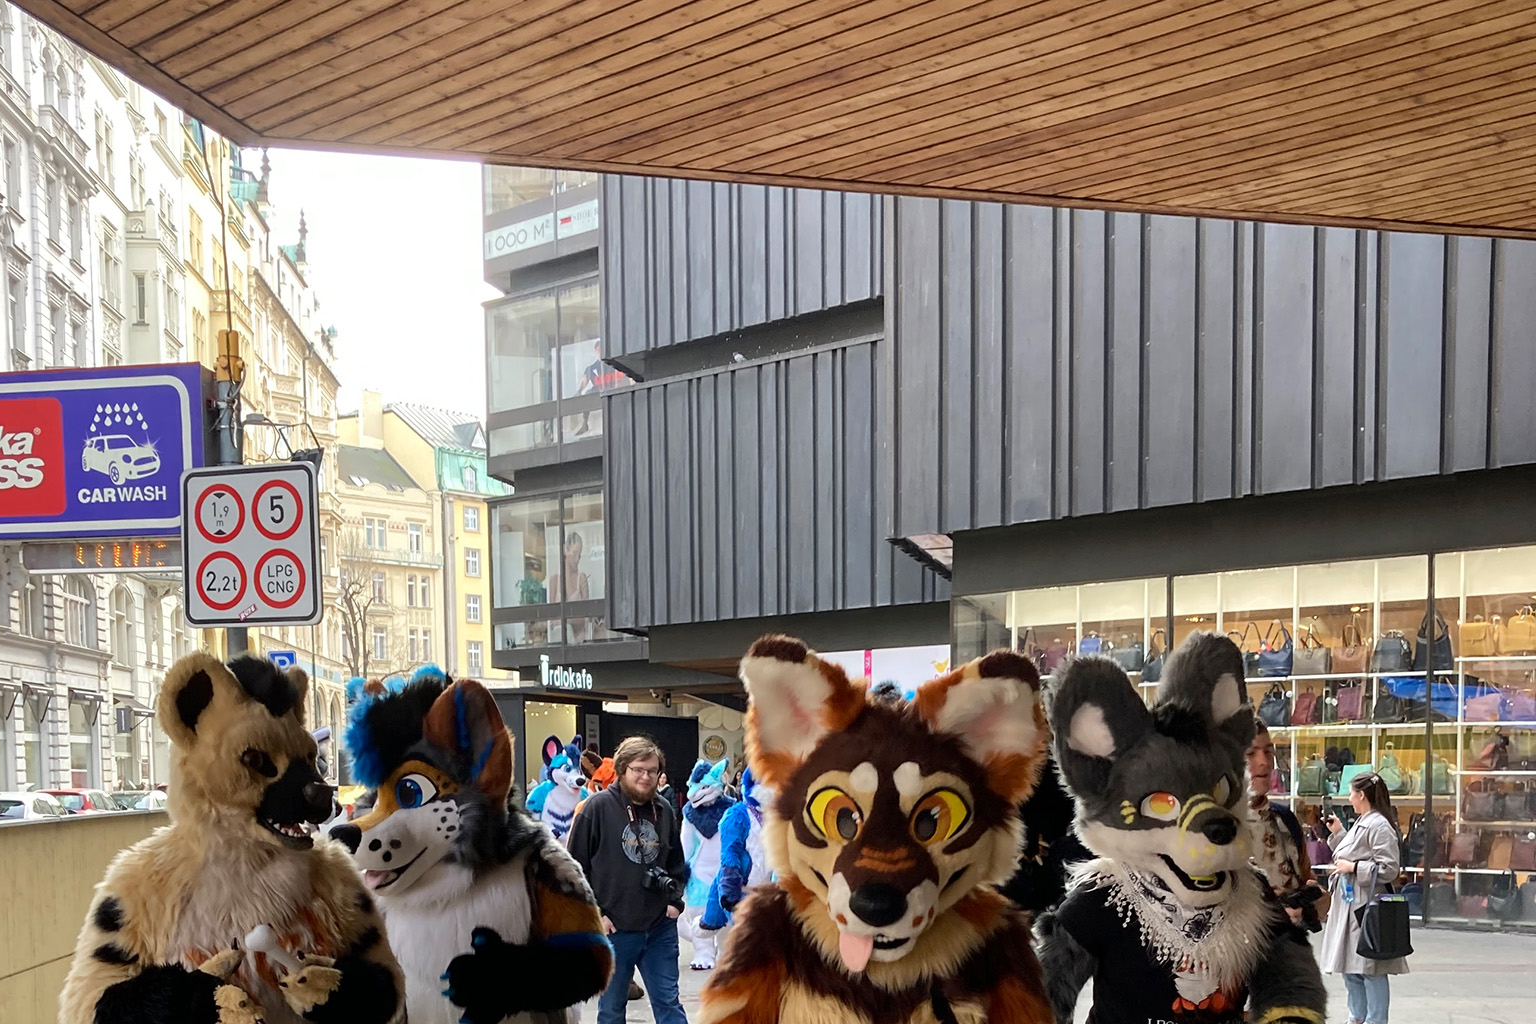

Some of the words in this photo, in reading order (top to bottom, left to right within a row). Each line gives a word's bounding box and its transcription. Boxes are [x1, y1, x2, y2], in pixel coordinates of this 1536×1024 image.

[212, 502, 230, 518] 1,9
[270, 495, 285, 524] 5
[267, 564, 293, 578] LPG
[267, 580, 294, 594] CNG
